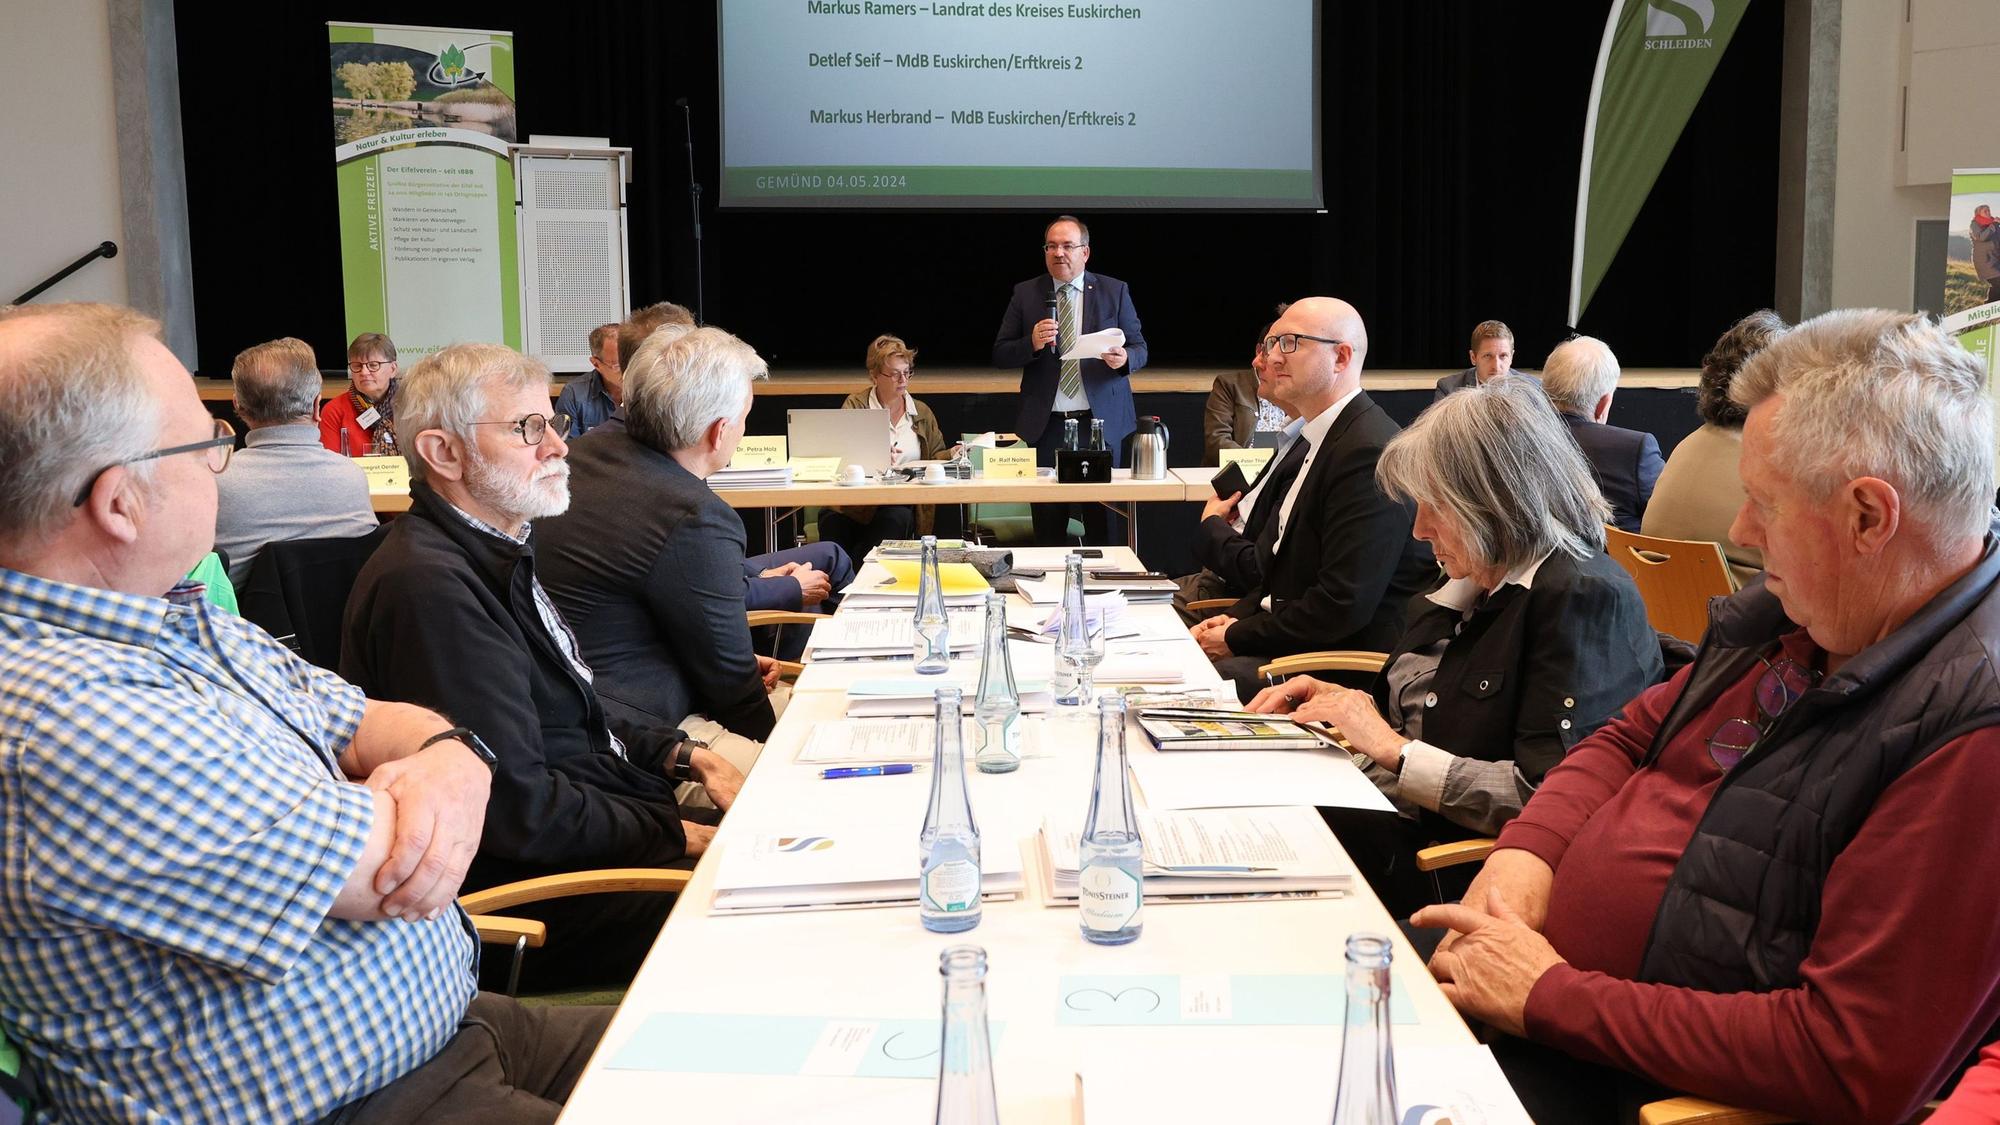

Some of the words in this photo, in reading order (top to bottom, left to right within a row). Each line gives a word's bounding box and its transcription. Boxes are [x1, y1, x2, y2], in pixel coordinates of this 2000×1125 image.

[808, 0, 861, 14] Markus
[864, 1, 917, 15] Ramers
[932, 2, 985, 16] Landrat
[988, 3, 1012, 17] des
[1016, 3, 1064, 18] Kreises
[1068, 4, 1141, 19] Euskirchen
[1645, 39, 1713, 50] SCHLEIDEN
[808, 53, 851, 68] Detlef
[855, 53, 881, 68] Seif
[896, 54, 929, 69] MdB
[933, 54, 1071, 72] Euskirchen/Erftkreis
[1074, 56, 1083, 70] 2
[810, 109, 863, 124] Markus
[866, 109, 931, 125] Herbrand
[951, 110, 984, 125] MdB
[988, 111, 1124, 128] Euskirchen/Erftkreis
[1128, 112, 1136, 126] 2
[355, 139, 379, 151] Natur
[381, 136, 388, 144] &
[390, 132, 415, 143] Kultur
[417, 130, 447, 138] erleben
[401, 166, 437, 174] Eifelverein
[443, 167, 456, 175] seit
[365, 165, 377, 210] FREIZEIT
[756, 172, 822, 189] GEMÜND
[827, 175, 906, 188] 04.05.2024
[368, 213, 379, 251] AKTIVE
